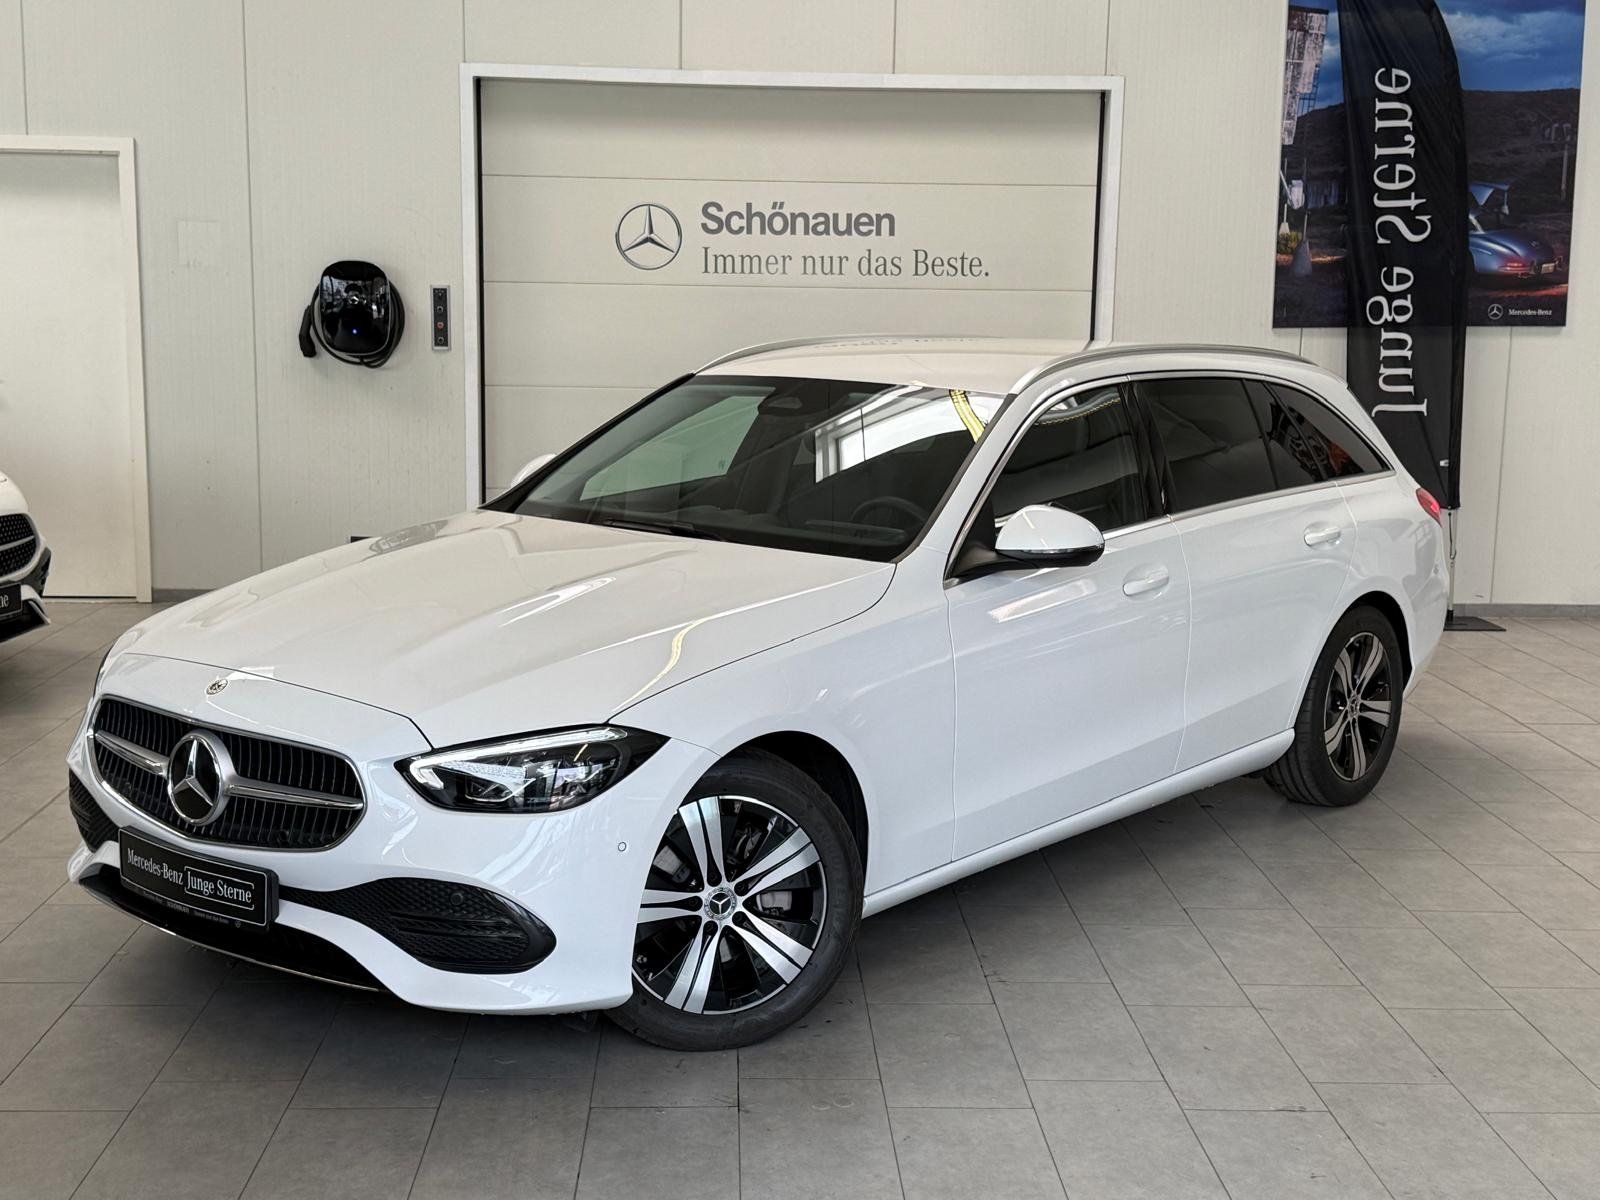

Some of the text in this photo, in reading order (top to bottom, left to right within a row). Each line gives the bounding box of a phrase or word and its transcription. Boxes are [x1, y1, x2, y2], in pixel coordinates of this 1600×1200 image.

[700, 201, 896, 237] Schönauen
[701, 246, 990, 278] Immer nur das Beste.
[1508, 308, 1553, 316] Mercedes-Benz
[127, 848, 252, 903] Mercedes-Benz Junge Sterne
